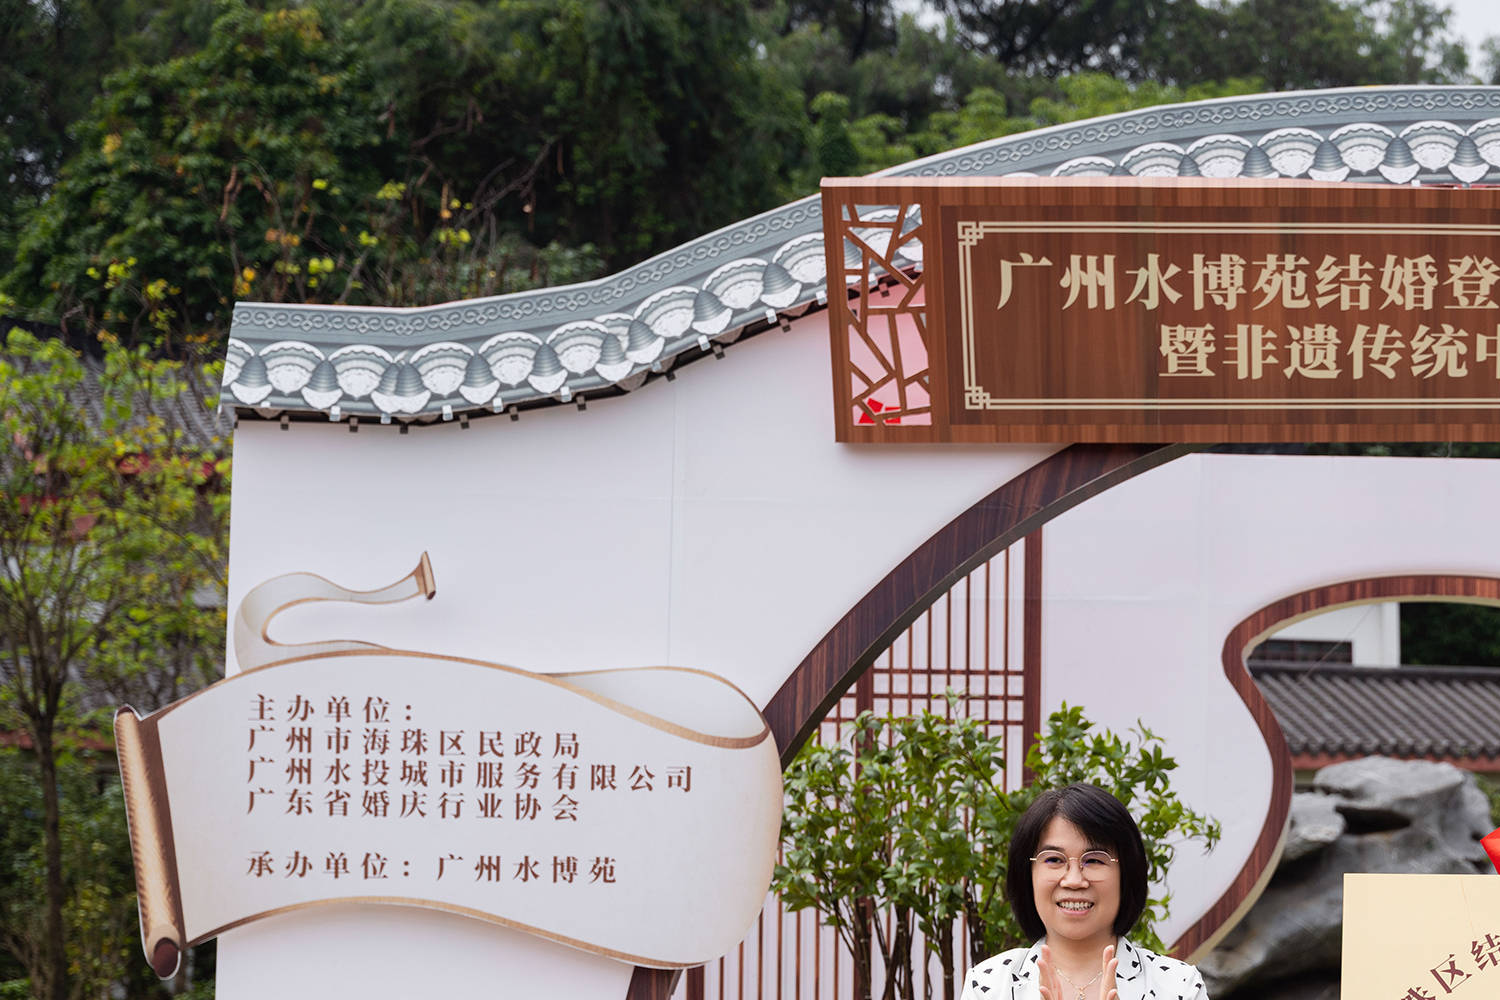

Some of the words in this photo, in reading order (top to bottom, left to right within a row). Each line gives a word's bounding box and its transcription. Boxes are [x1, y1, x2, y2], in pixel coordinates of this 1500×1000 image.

[248, 693, 413, 723] 主办单位：
[247, 725, 580, 758] 广州市海珠区民政局
[247, 756, 693, 793] 广州水投城市服务有限公司
[247, 788, 580, 822] 广东省婚庆行业协会
